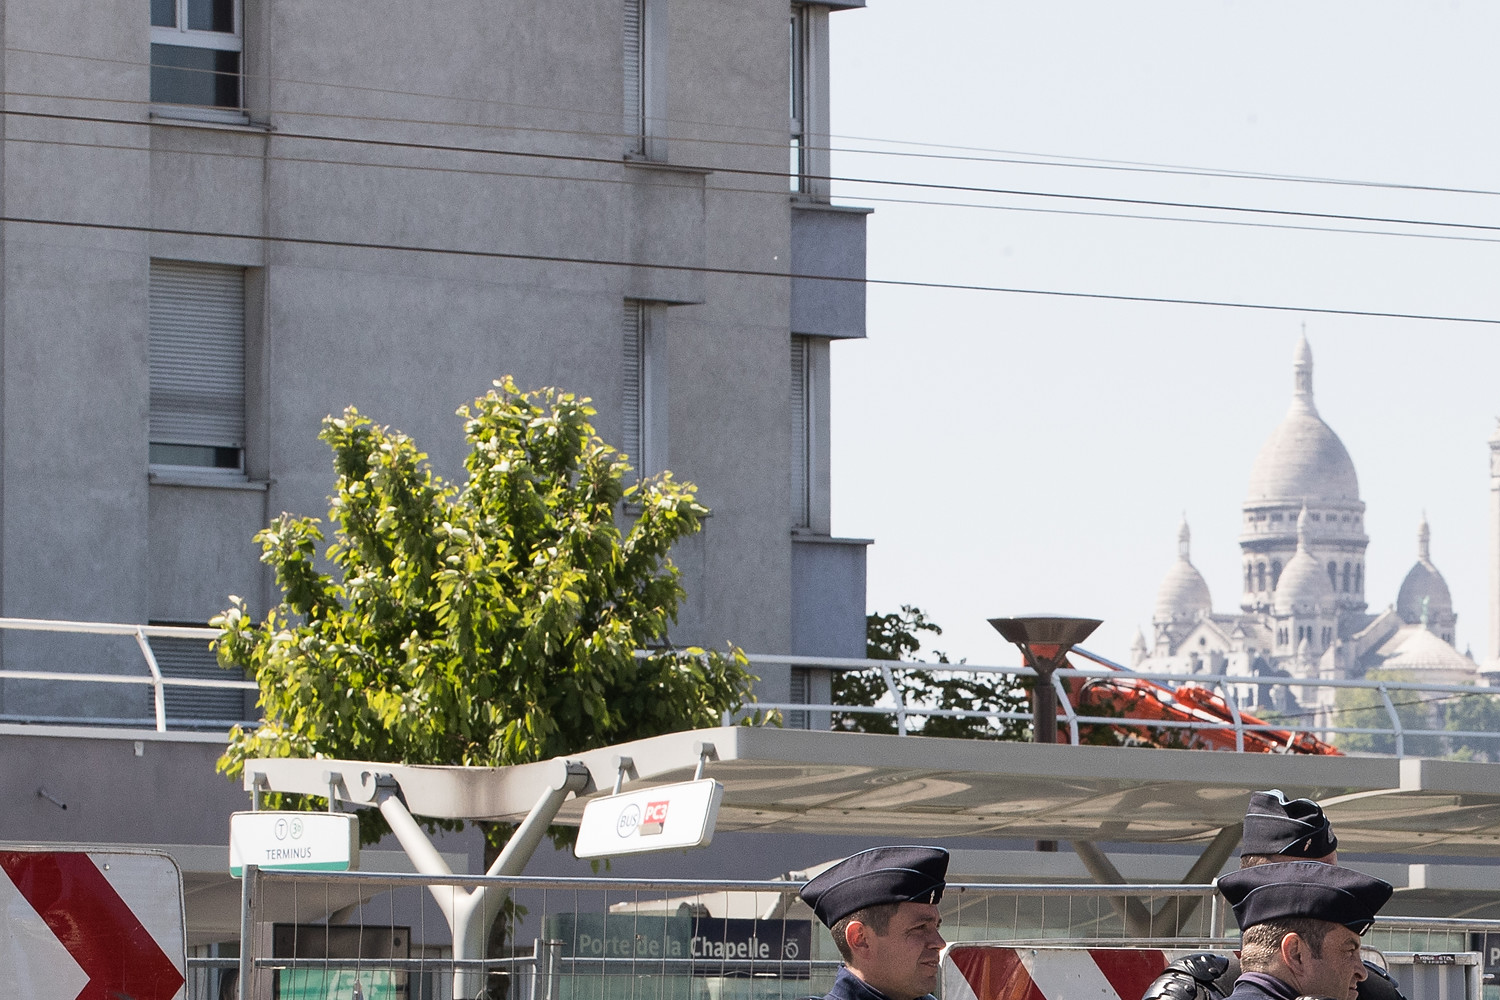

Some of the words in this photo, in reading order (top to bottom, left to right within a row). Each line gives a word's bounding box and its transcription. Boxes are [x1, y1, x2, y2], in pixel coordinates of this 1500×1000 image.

[620, 813, 638, 828] BUS
[645, 804, 668, 821] PC3
[266, 847, 312, 860] TERMINUS
[579, 934, 630, 954] Porte
[636, 934, 660, 956] de
[665, 935, 682, 956] la
[690, 936, 770, 959] Chapelle
